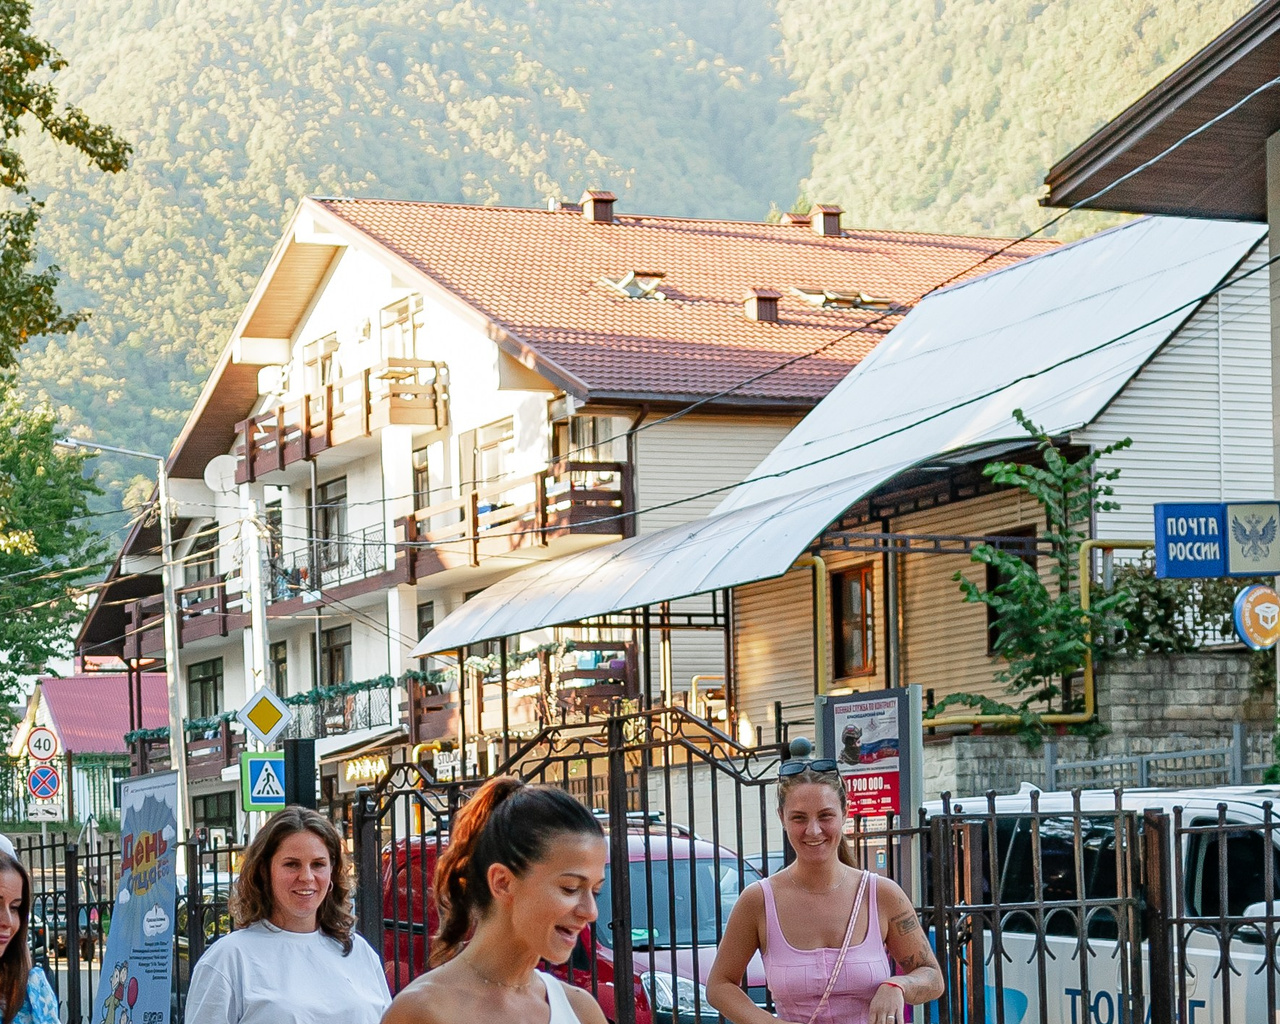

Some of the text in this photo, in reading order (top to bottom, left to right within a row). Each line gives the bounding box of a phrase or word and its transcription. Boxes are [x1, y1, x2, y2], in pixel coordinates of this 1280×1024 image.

[1166, 517, 1219, 536] ПОЧТА
[1168, 541, 1220, 561] РОССИИ
[33, 737, 51, 752] 40
[852, 778, 868, 792] 900
[868, 776, 884, 791] 000
